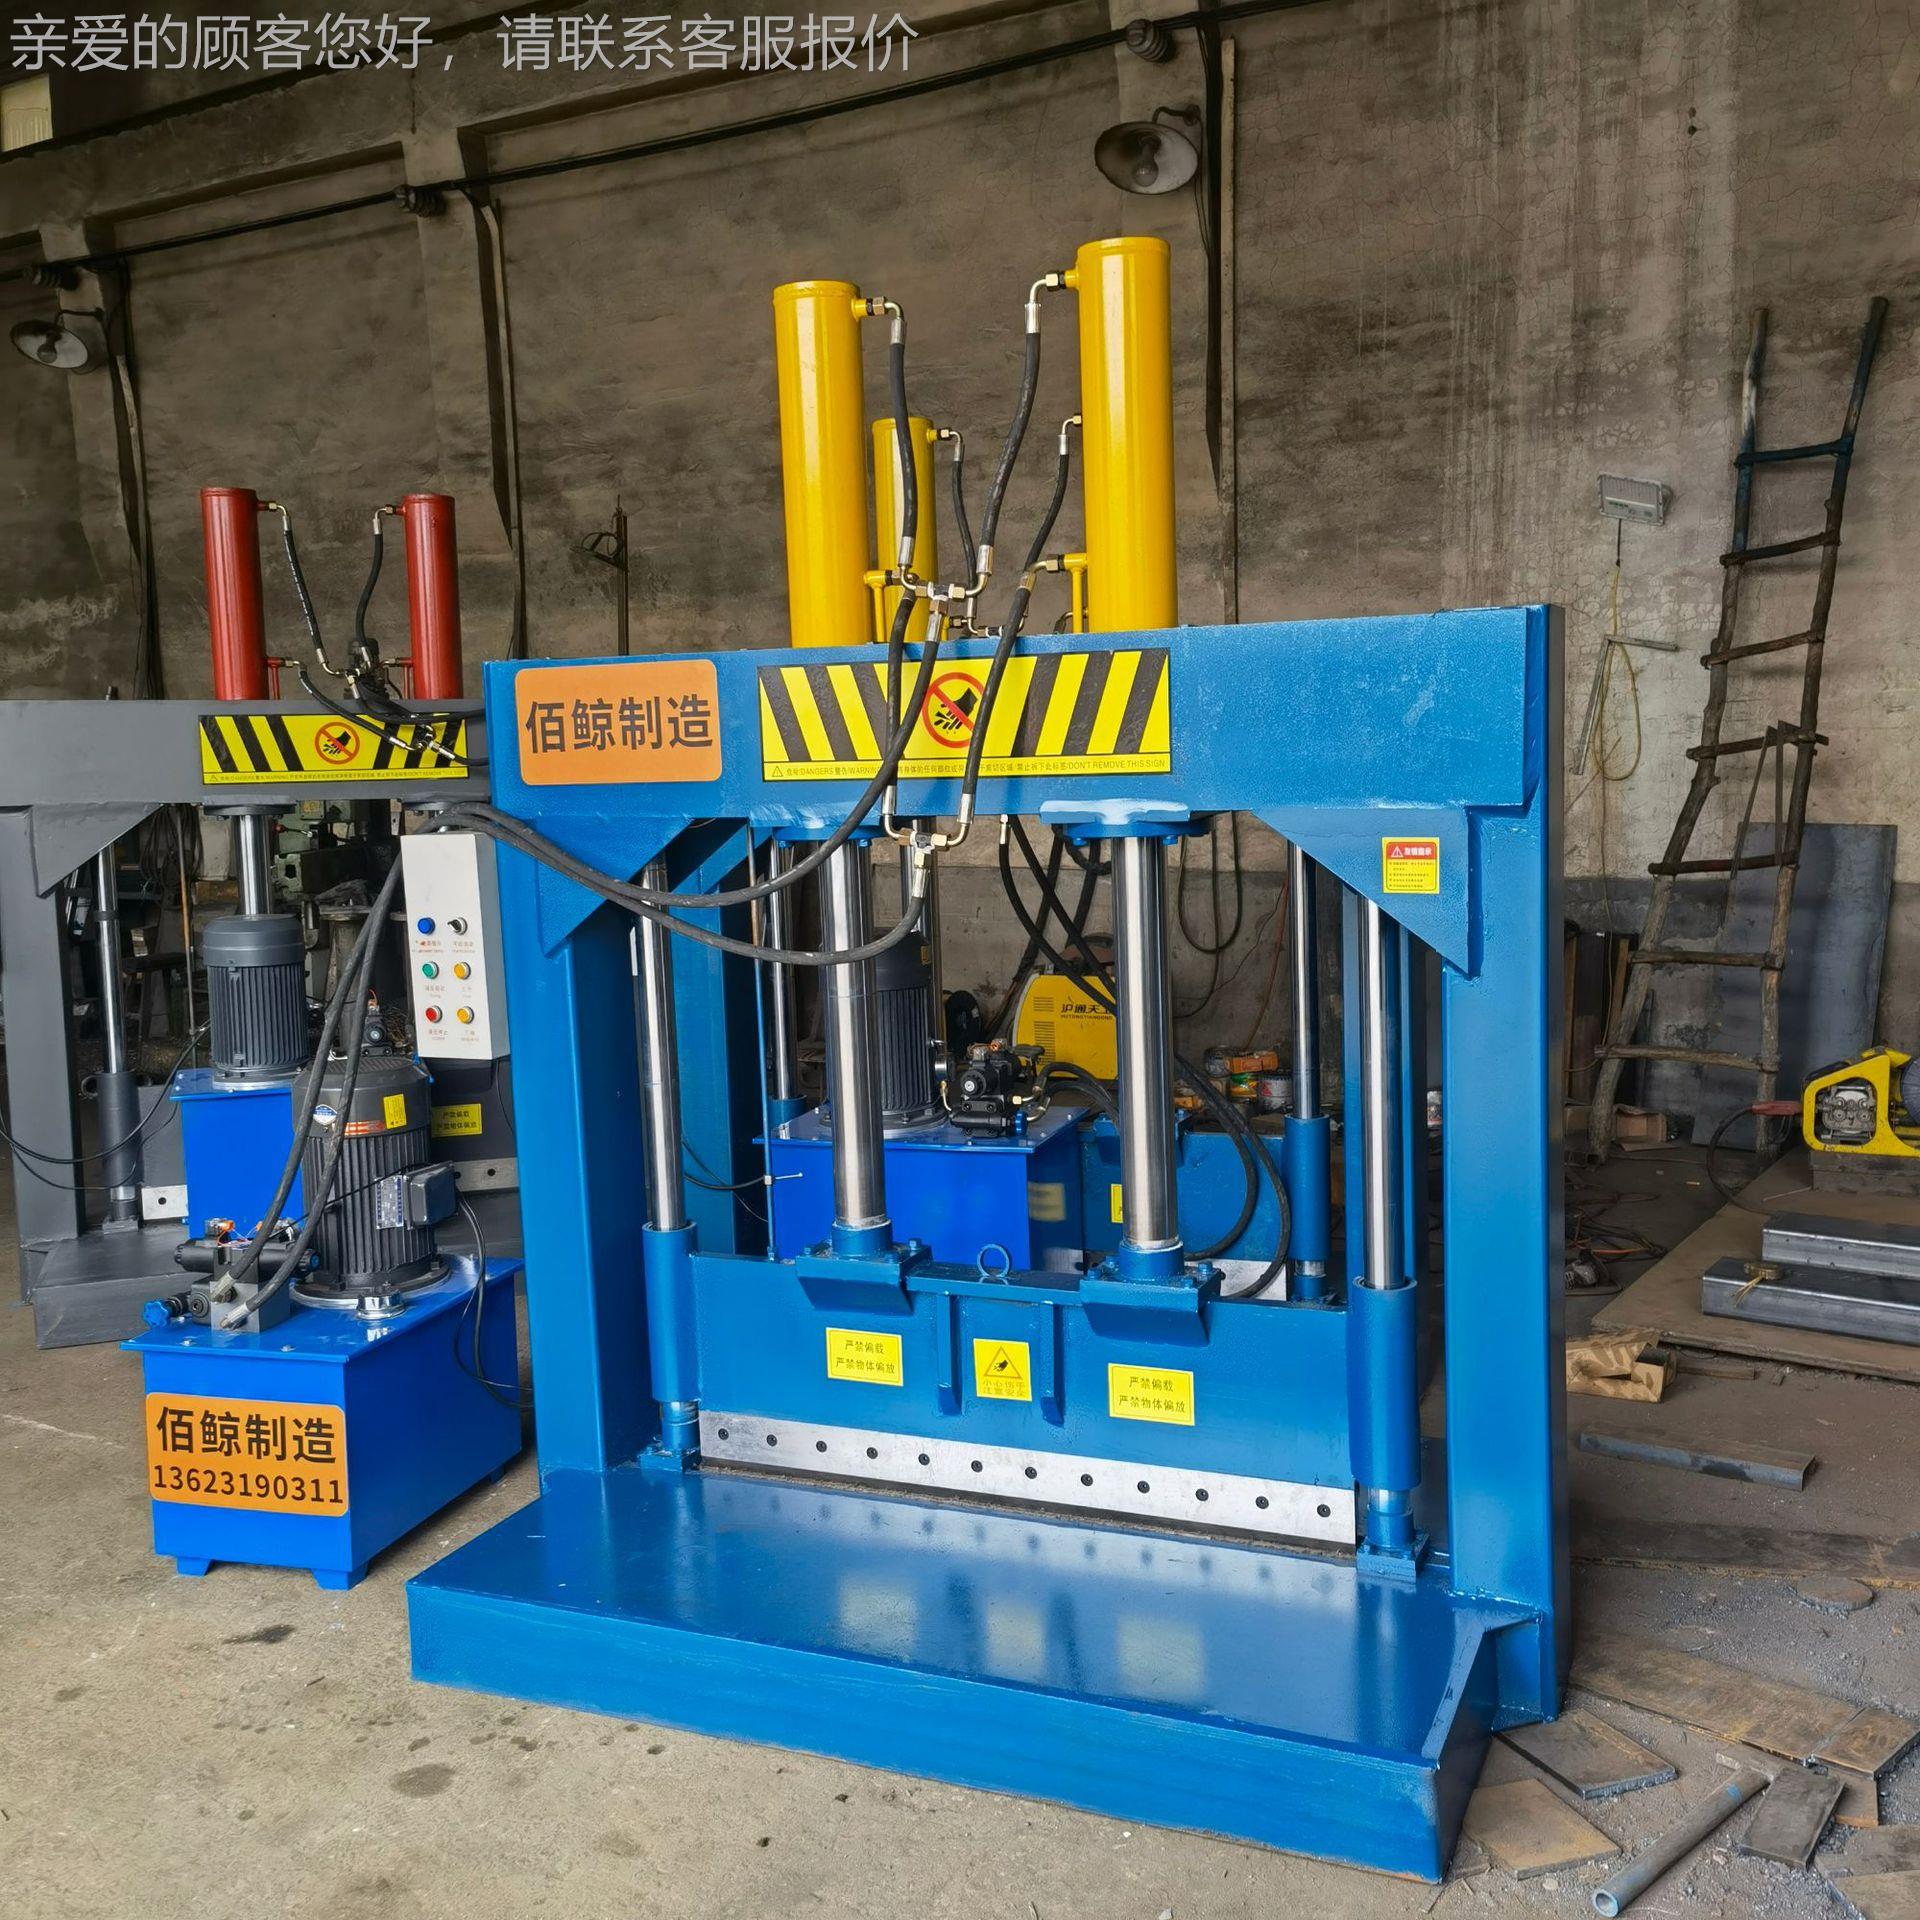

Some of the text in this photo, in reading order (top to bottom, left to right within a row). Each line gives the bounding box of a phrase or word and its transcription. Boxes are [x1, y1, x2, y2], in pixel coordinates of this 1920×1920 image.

[525, 694, 713, 754] 佰鲸制造
[1092, 760, 1126, 770] REMOVE
[1127, 759, 1144, 769] THIS
[1145, 758, 1166, 768] SIGN
[844, 1339, 885, 1354] 严禁偏载
[836, 1356, 895, 1375] 严禁物体偏放
[1128, 1376, 1174, 1392] 严禁偏载
[1118, 1394, 1186, 1414] 严禁物体偏放
[156, 1406, 336, 1464] 佰鲸制造
[154, 1464, 344, 1504] 13623190311
